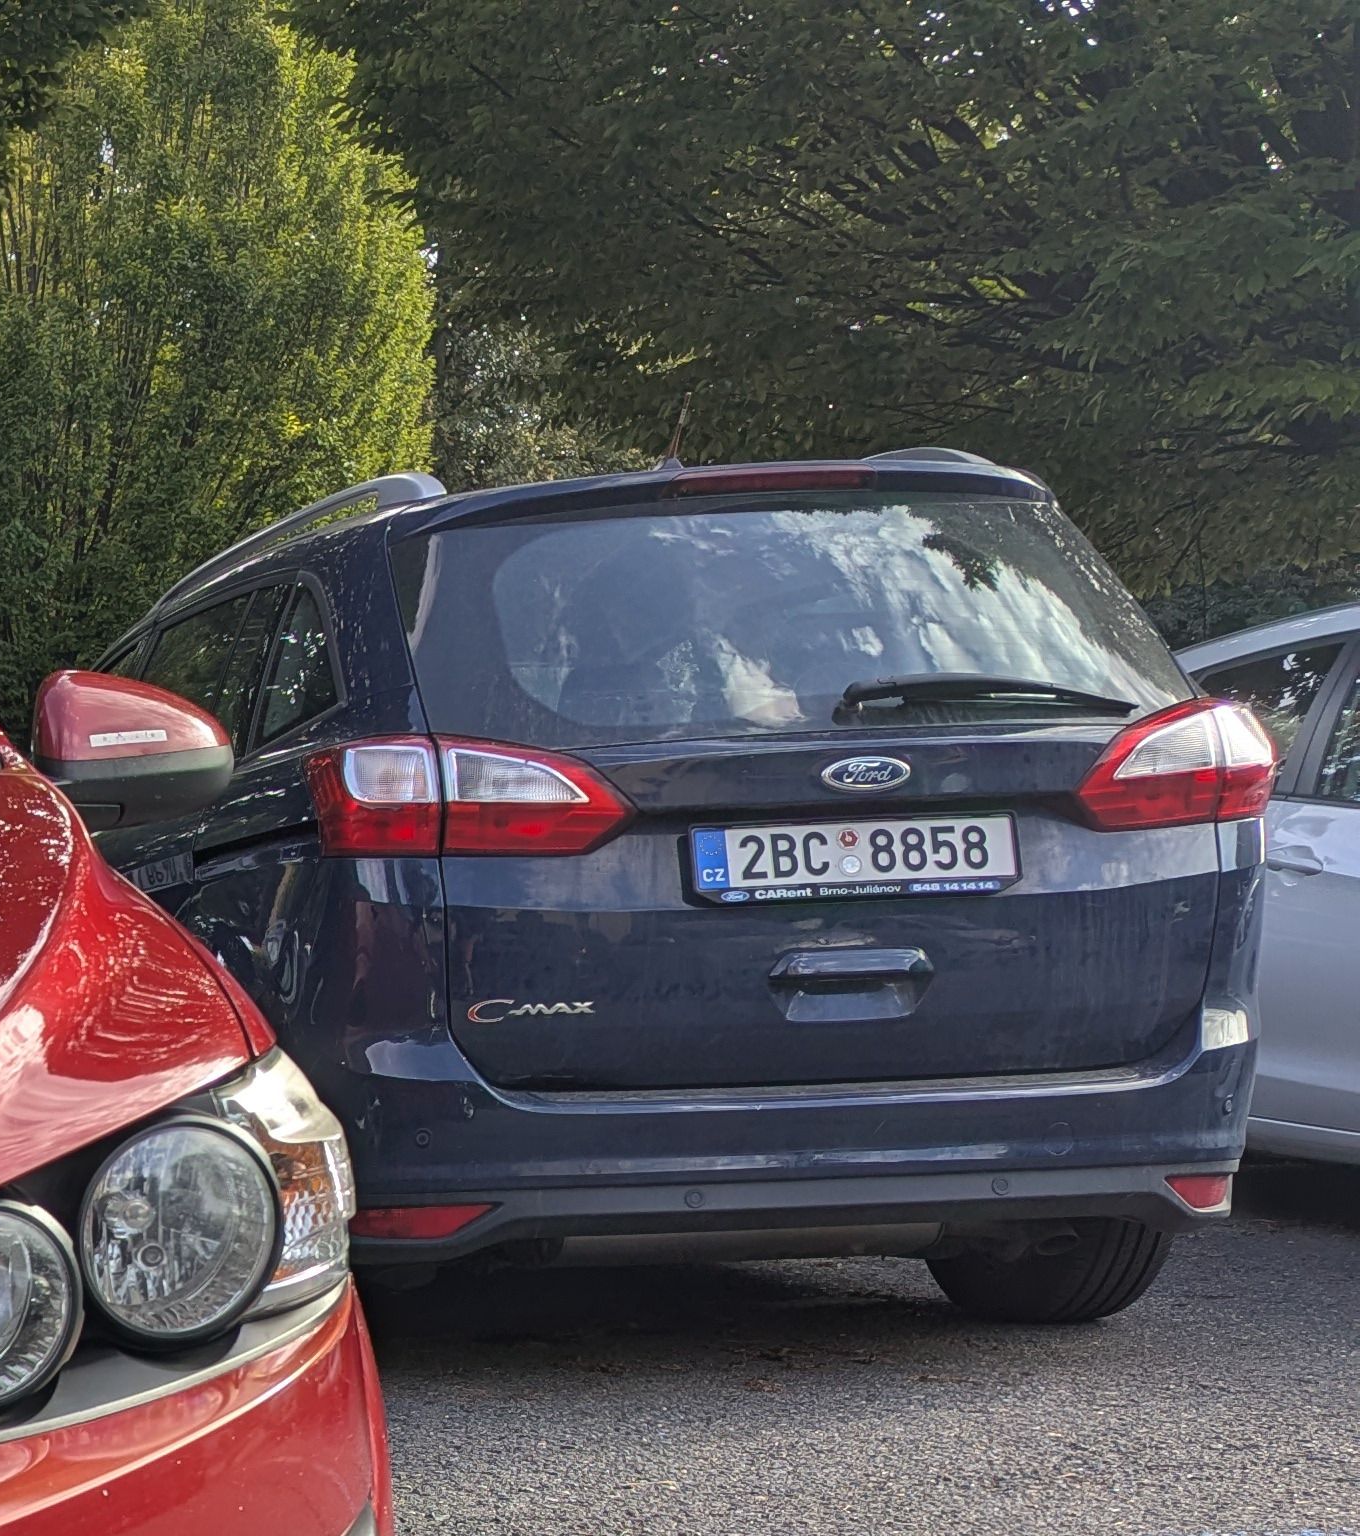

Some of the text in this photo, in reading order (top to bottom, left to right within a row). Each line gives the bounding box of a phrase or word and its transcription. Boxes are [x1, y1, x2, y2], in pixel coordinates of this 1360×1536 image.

[843, 762, 893, 783] Ford
[703, 825, 989, 882] CZ 2BC 8858
[755, 887, 812, 899] CARent
[820, 884, 901, 896] Brno-Juliánov
